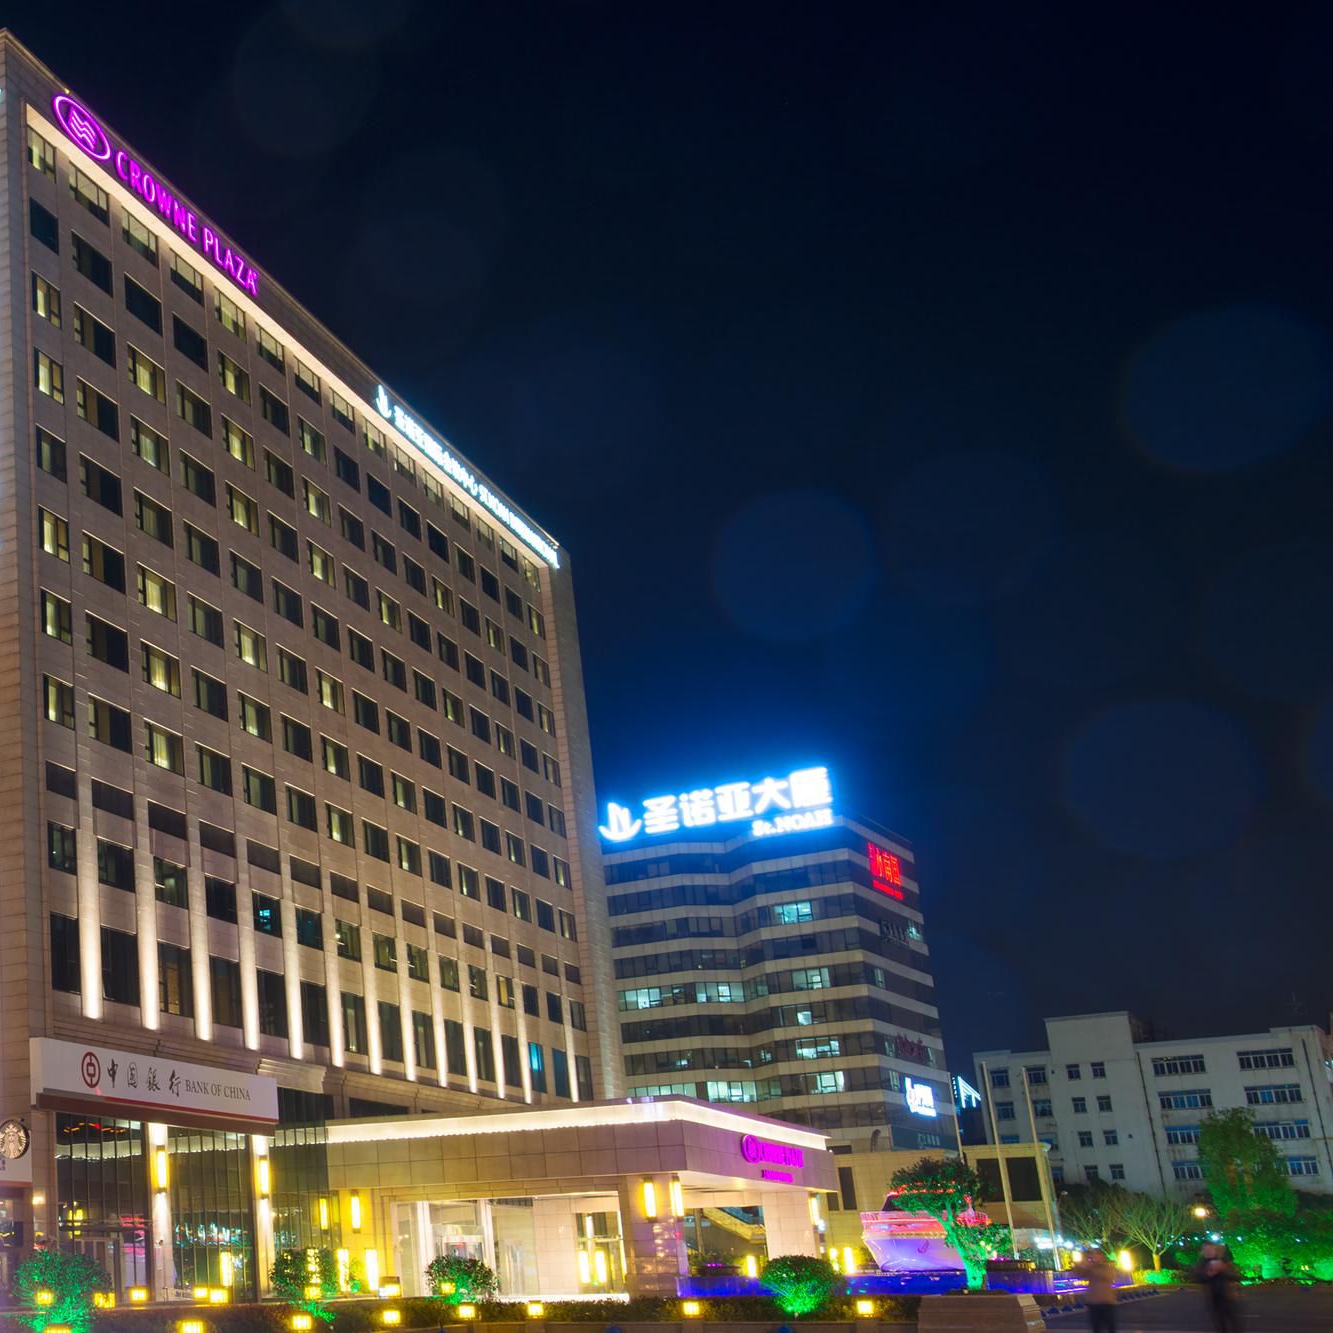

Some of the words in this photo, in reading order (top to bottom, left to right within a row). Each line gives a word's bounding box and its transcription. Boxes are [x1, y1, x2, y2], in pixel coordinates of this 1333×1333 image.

[116, 151, 197, 242] CROWNE
[185, 1079, 209, 1096] BANK
[211, 1081, 222, 1097] OF
[223, 1085, 251, 1101] CHINA
